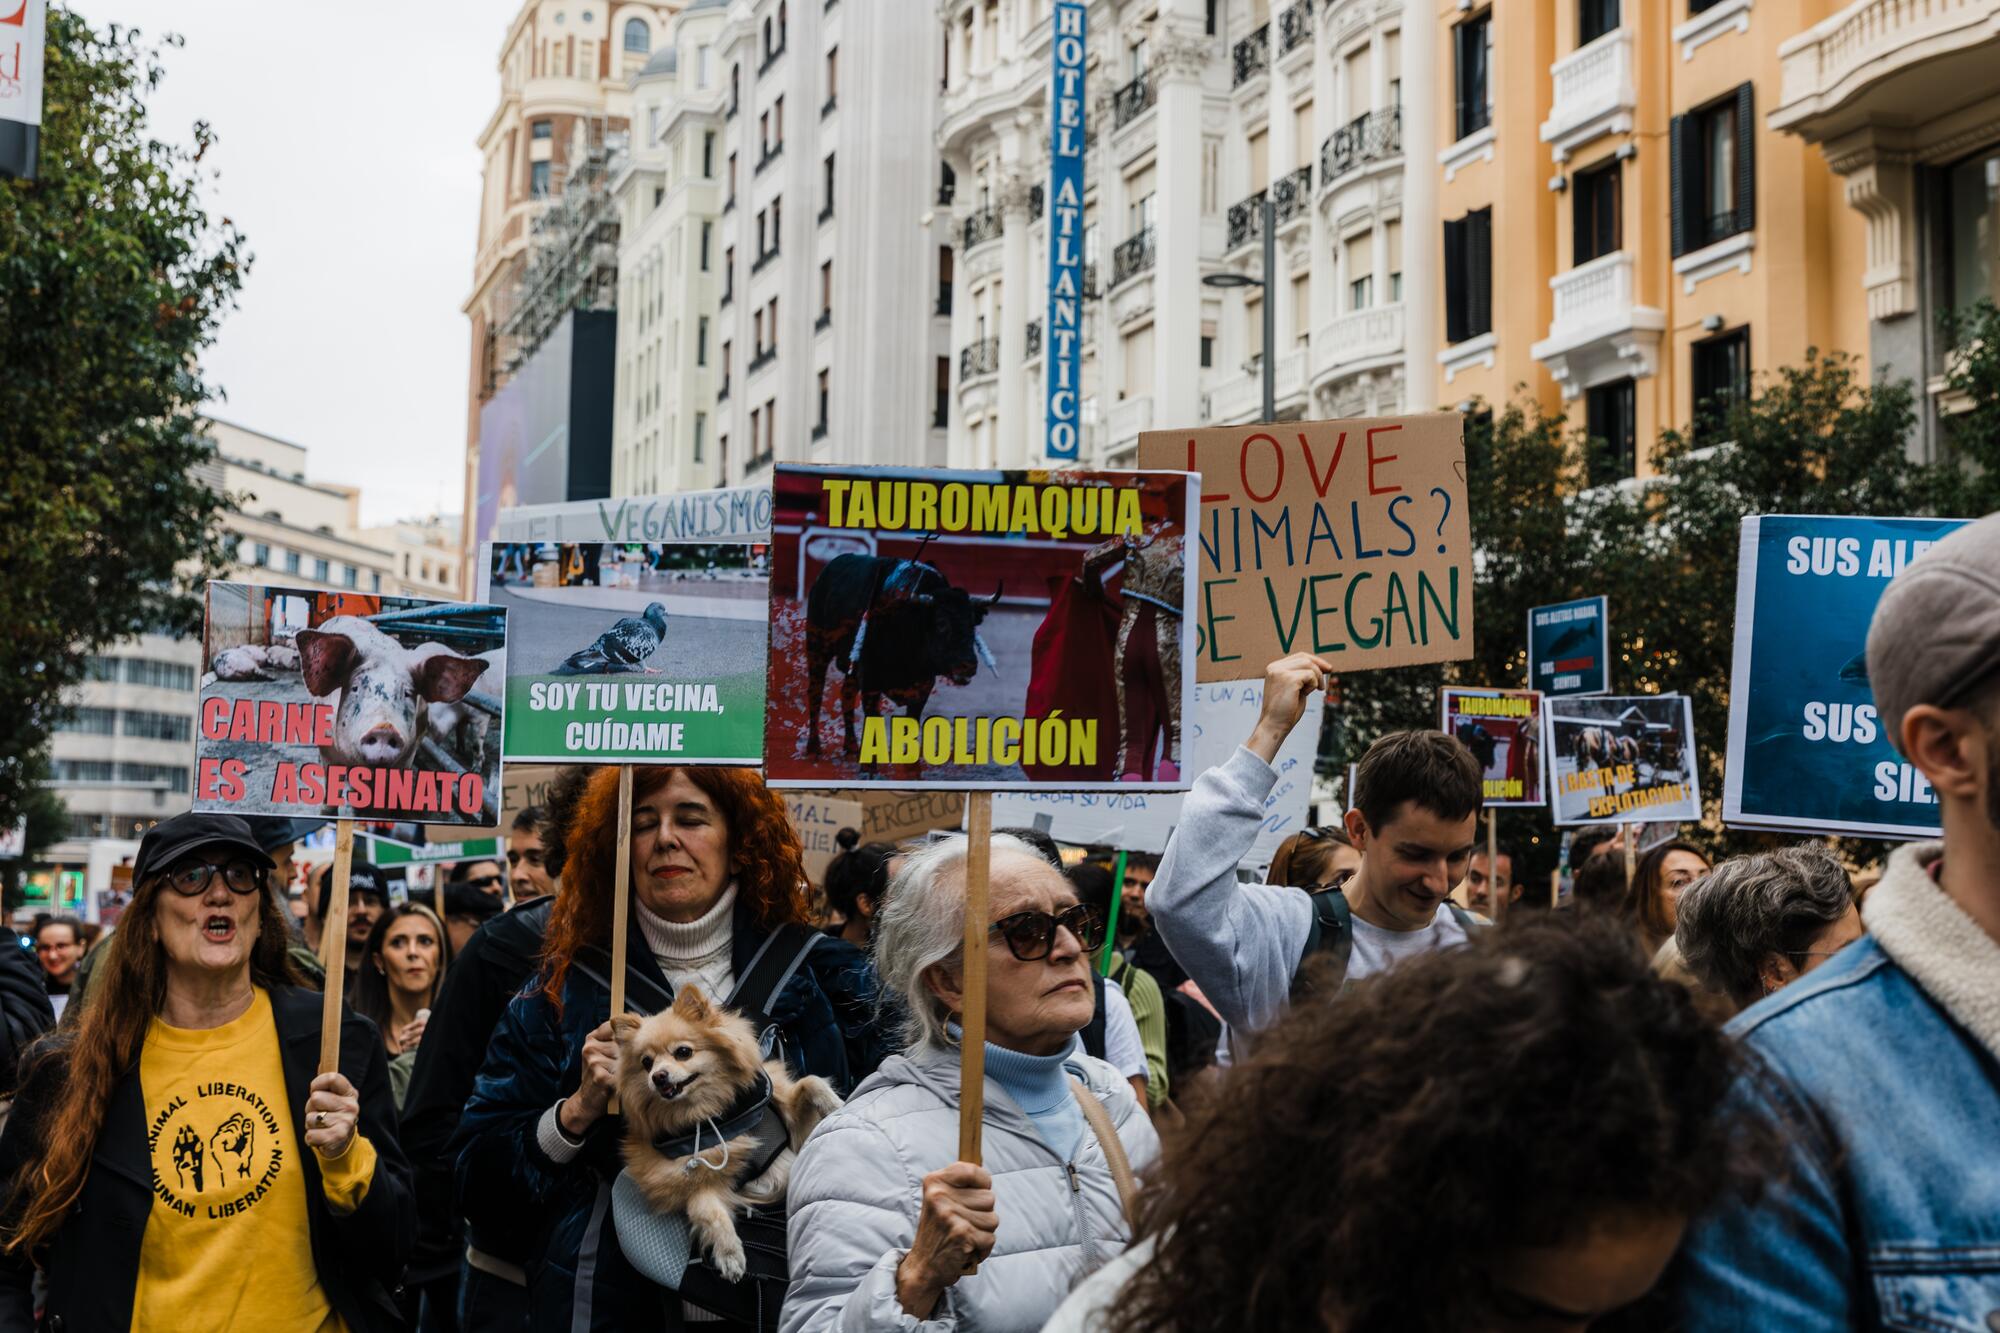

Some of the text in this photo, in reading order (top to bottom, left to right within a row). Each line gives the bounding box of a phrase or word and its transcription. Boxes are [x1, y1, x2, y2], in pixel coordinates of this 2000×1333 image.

[1050, 7, 1083, 453] HOTEL ATLANTICO
[1187, 425, 1403, 504] LOVE
[598, 489, 772, 541] VEGANISMO
[822, 479, 1144, 538] TAUROMAQUIA
[1198, 487, 1451, 574] NIMALS?
[1787, 535, 1860, 577] SUS
[1264, 566, 1460, 655] VEGAN
[201, 696, 335, 746] CARNE
[529, 682, 725, 715] SOY TU VECINA,
[1803, 701, 1877, 744] SUS
[565, 717, 685, 751] CUÍDAME
[859, 709, 1099, 767] ABOLICIÓN
[198, 758, 484, 815] ES ASESINATO
[1106, 794, 1146, 810] VIDA
[1483, 777, 1523, 798] OLICIÓN
[1874, 761, 1940, 804] SIE
[148, 1082, 280, 1153] ANIMAL LIBERATION
[208, 1149, 283, 1219] LIBERATION
